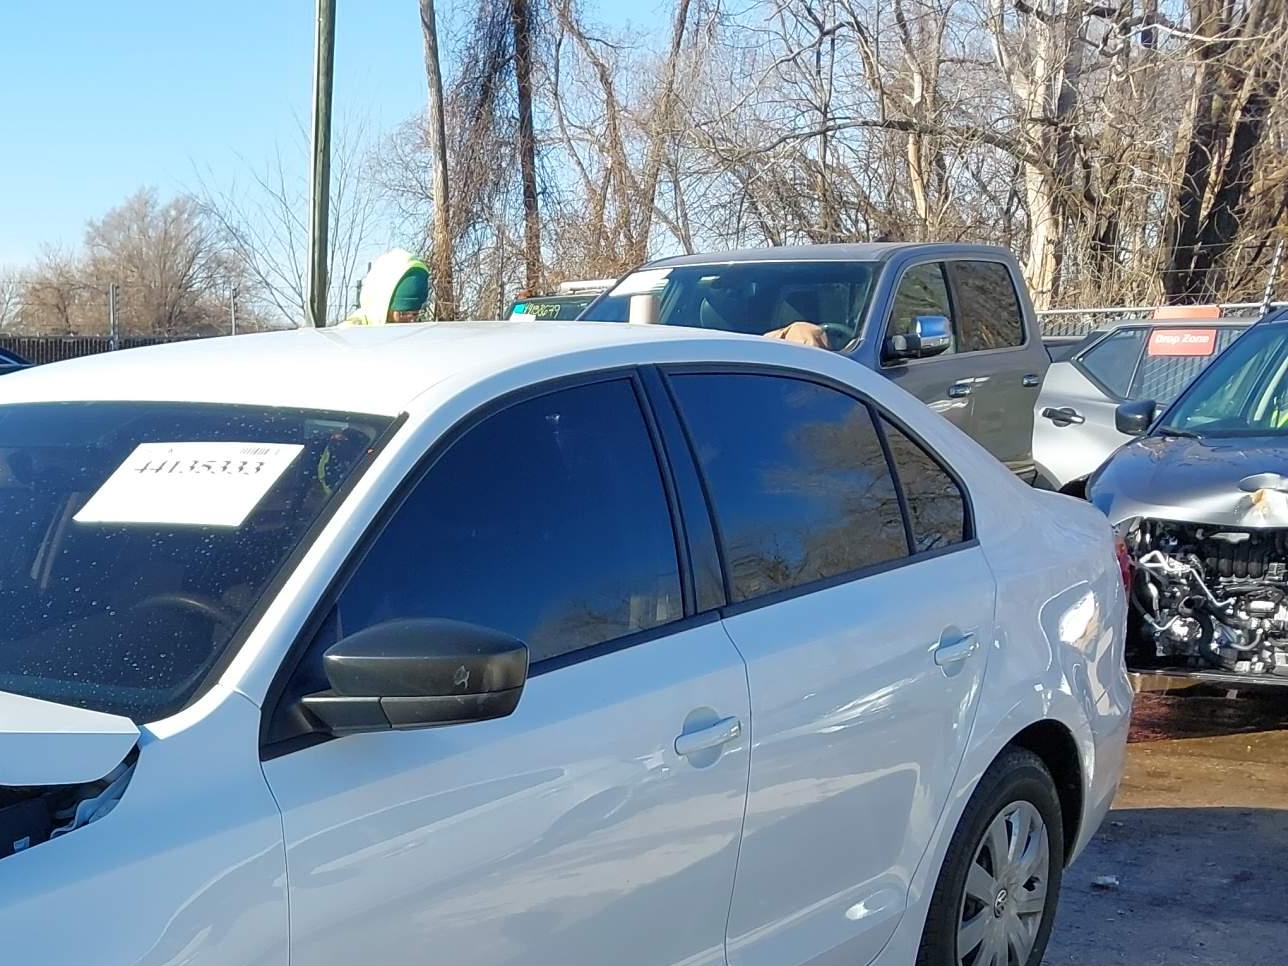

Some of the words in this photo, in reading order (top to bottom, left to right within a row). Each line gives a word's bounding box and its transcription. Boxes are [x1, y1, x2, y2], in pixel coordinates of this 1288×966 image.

[1155, 334, 1181, 345] Drop
[1182, 333, 1210, 344] Zone
[134, 460, 265, 475] 44135333
